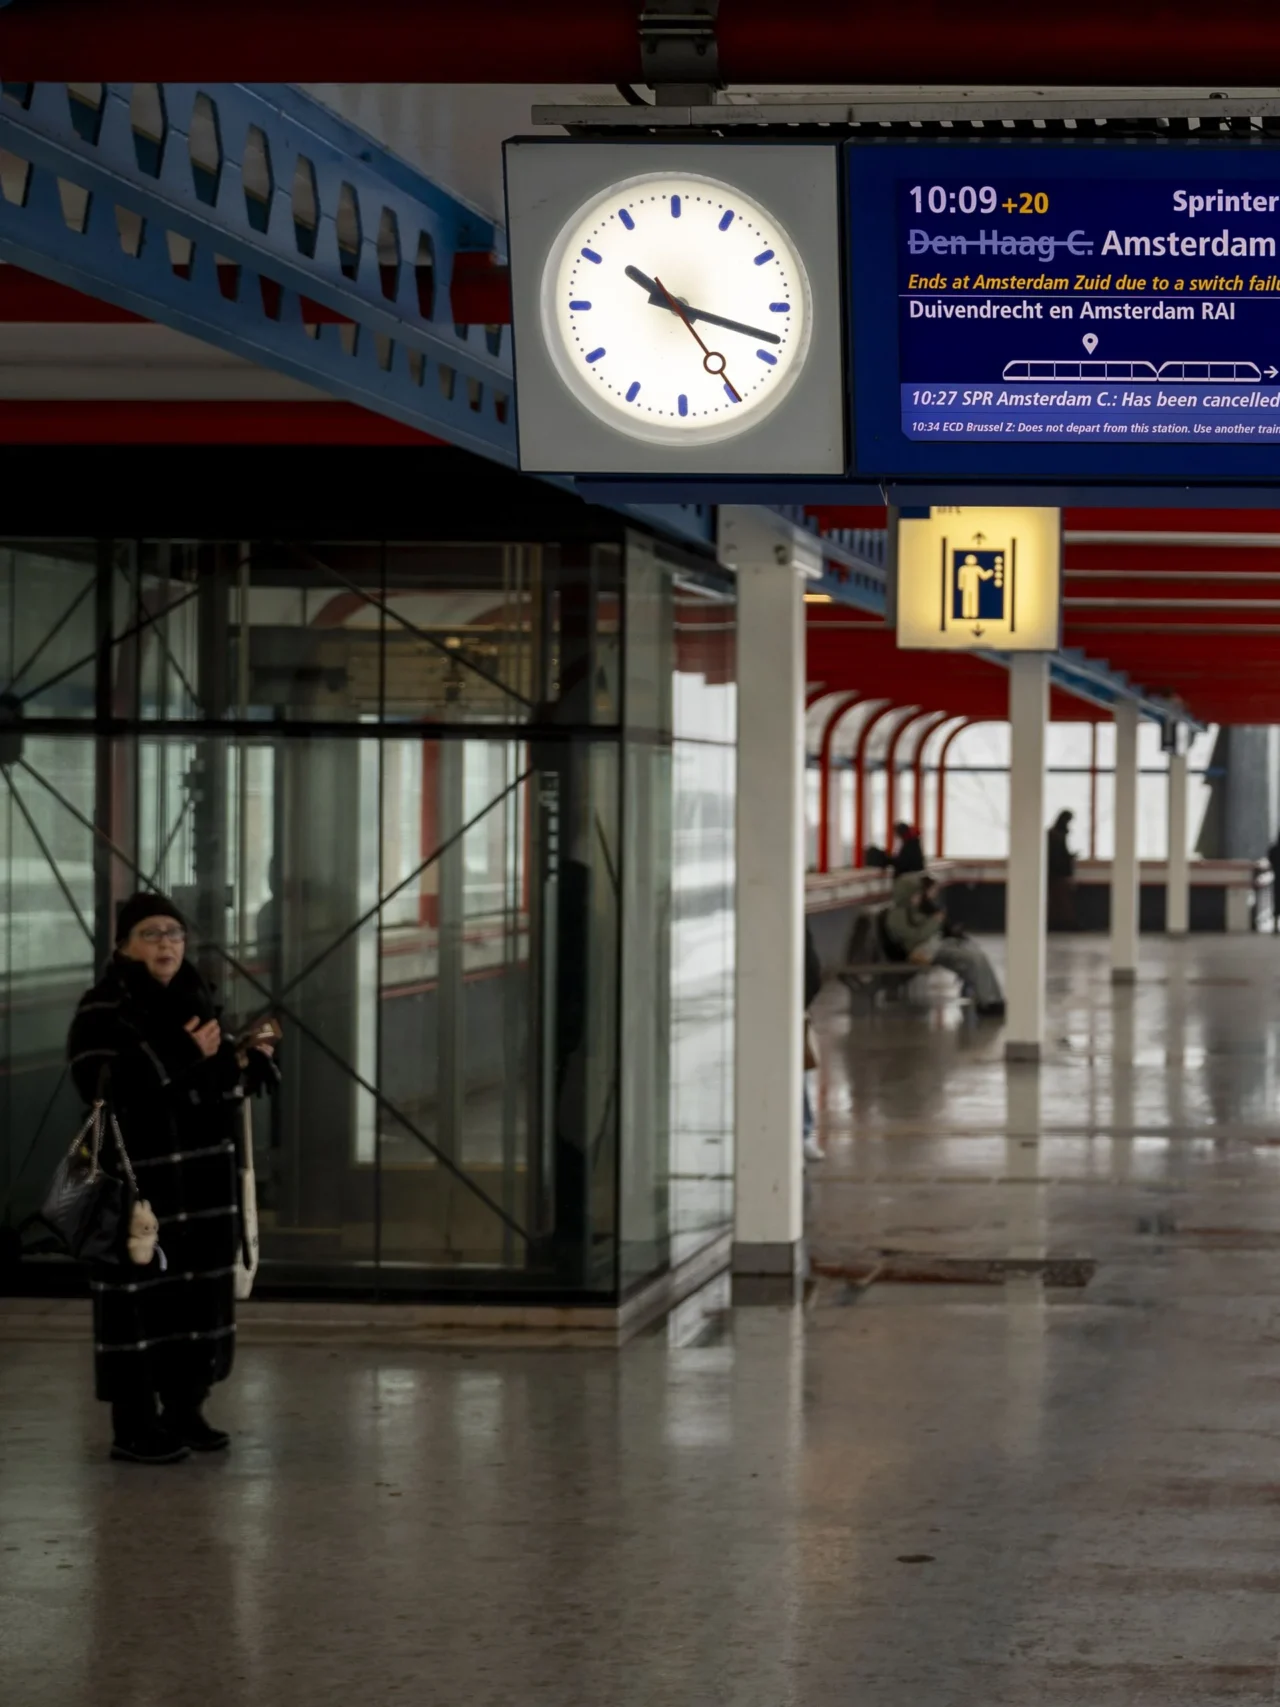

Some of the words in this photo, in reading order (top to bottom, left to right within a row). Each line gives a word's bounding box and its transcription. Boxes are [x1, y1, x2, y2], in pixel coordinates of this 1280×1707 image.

[909, 185, 998, 214] 10:09
[1001, 192, 1050, 214] +20
[1173, 188, 1280, 218] Sprinter
[908, 229, 968, 255] Den
[979, 229, 1056, 263] Haag
[1066, 230, 1094, 256] C.
[1100, 228, 1277, 257] Amsterdam
[907, 273, 948, 290] Ends
[952, 275, 970, 290] at
[972, 273, 1070, 291] Amsterdam
[1073, 274, 1112, 291] Zuid
[1115, 274, 1147, 291] due
[1152, 276, 1170, 291] to
[1173, 278, 1185, 291] a
[1189, 274, 1244, 292] switch
[909, 299, 1044, 320] Duivendrecht
[1049, 305, 1074, 320] en
[1079, 300, 1196, 321] Amsterdam
[1201, 302, 1236, 321] RAI
[911, 390, 958, 406] 10:27
[961, 390, 994, 406] SPR
[996, 390, 1092, 407] Amsterdam
[1096, 391, 1118, 407] C.:
[1121, 391, 1152, 408] Has
[1156, 391, 1198, 408] been
[911, 421, 940, 432] 10:34
[942, 421, 964, 432] ECD
[966, 421, 1004, 433] Brussel
[1005, 422, 1016, 433] Z:
[1017, 422, 1044, 433] Does
[1045, 422, 1065, 433] not
[1066, 422, 1101, 435] depart
[1102, 422, 1128, 434] from
[1130, 422, 1150, 434] this
[1151, 423, 1191, 434] station.
[1193, 423, 1212, 434] Use
[1213, 423, 1257, 434] another
